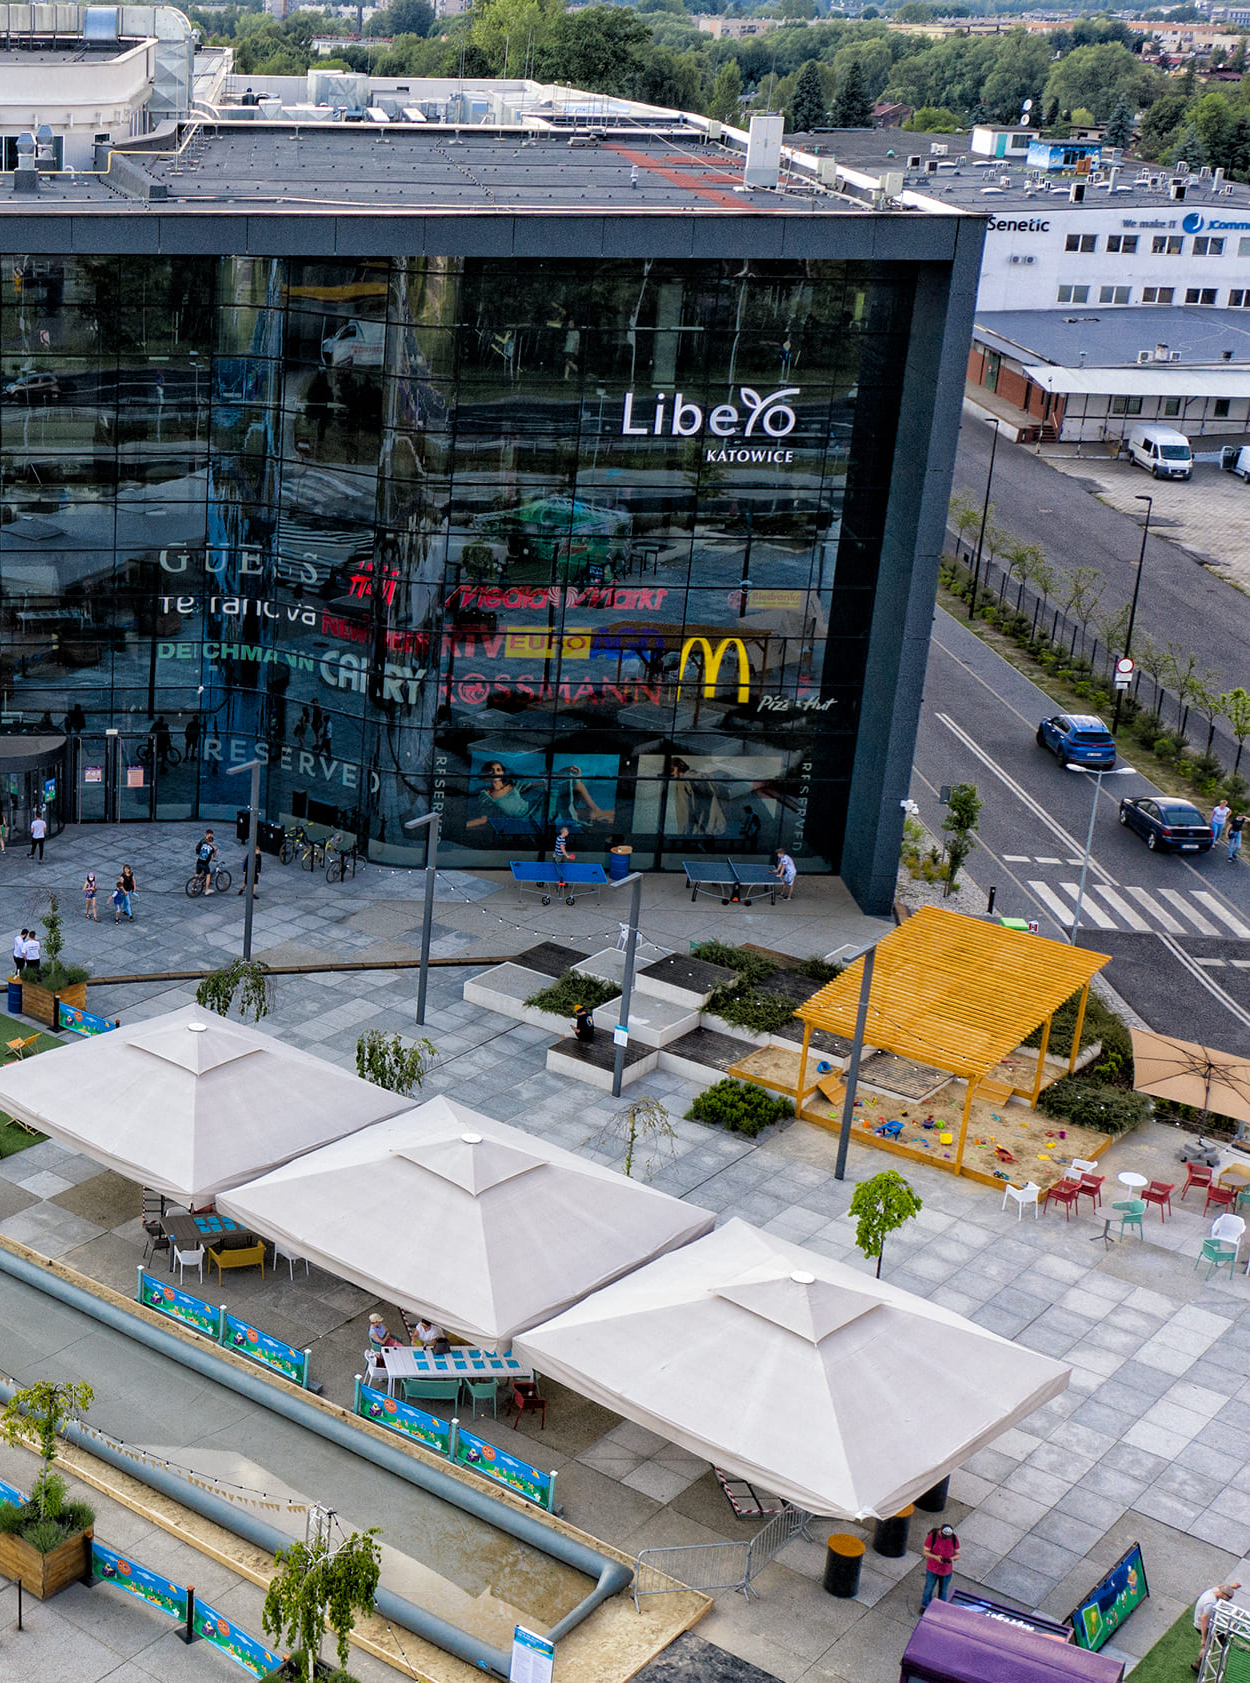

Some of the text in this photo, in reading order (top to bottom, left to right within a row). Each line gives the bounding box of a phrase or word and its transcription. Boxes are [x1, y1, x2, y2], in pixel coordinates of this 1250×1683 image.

[987, 216, 1050, 233] Senetic
[1122, 218, 1177, 229] We make IT
[1207, 220, 1250, 231] JComm
[622, 387, 800, 437] Libero
[706, 449, 794, 463] KATOWICE
[440, 624, 506, 658] RTV
[803, 695, 839, 712] Hut
